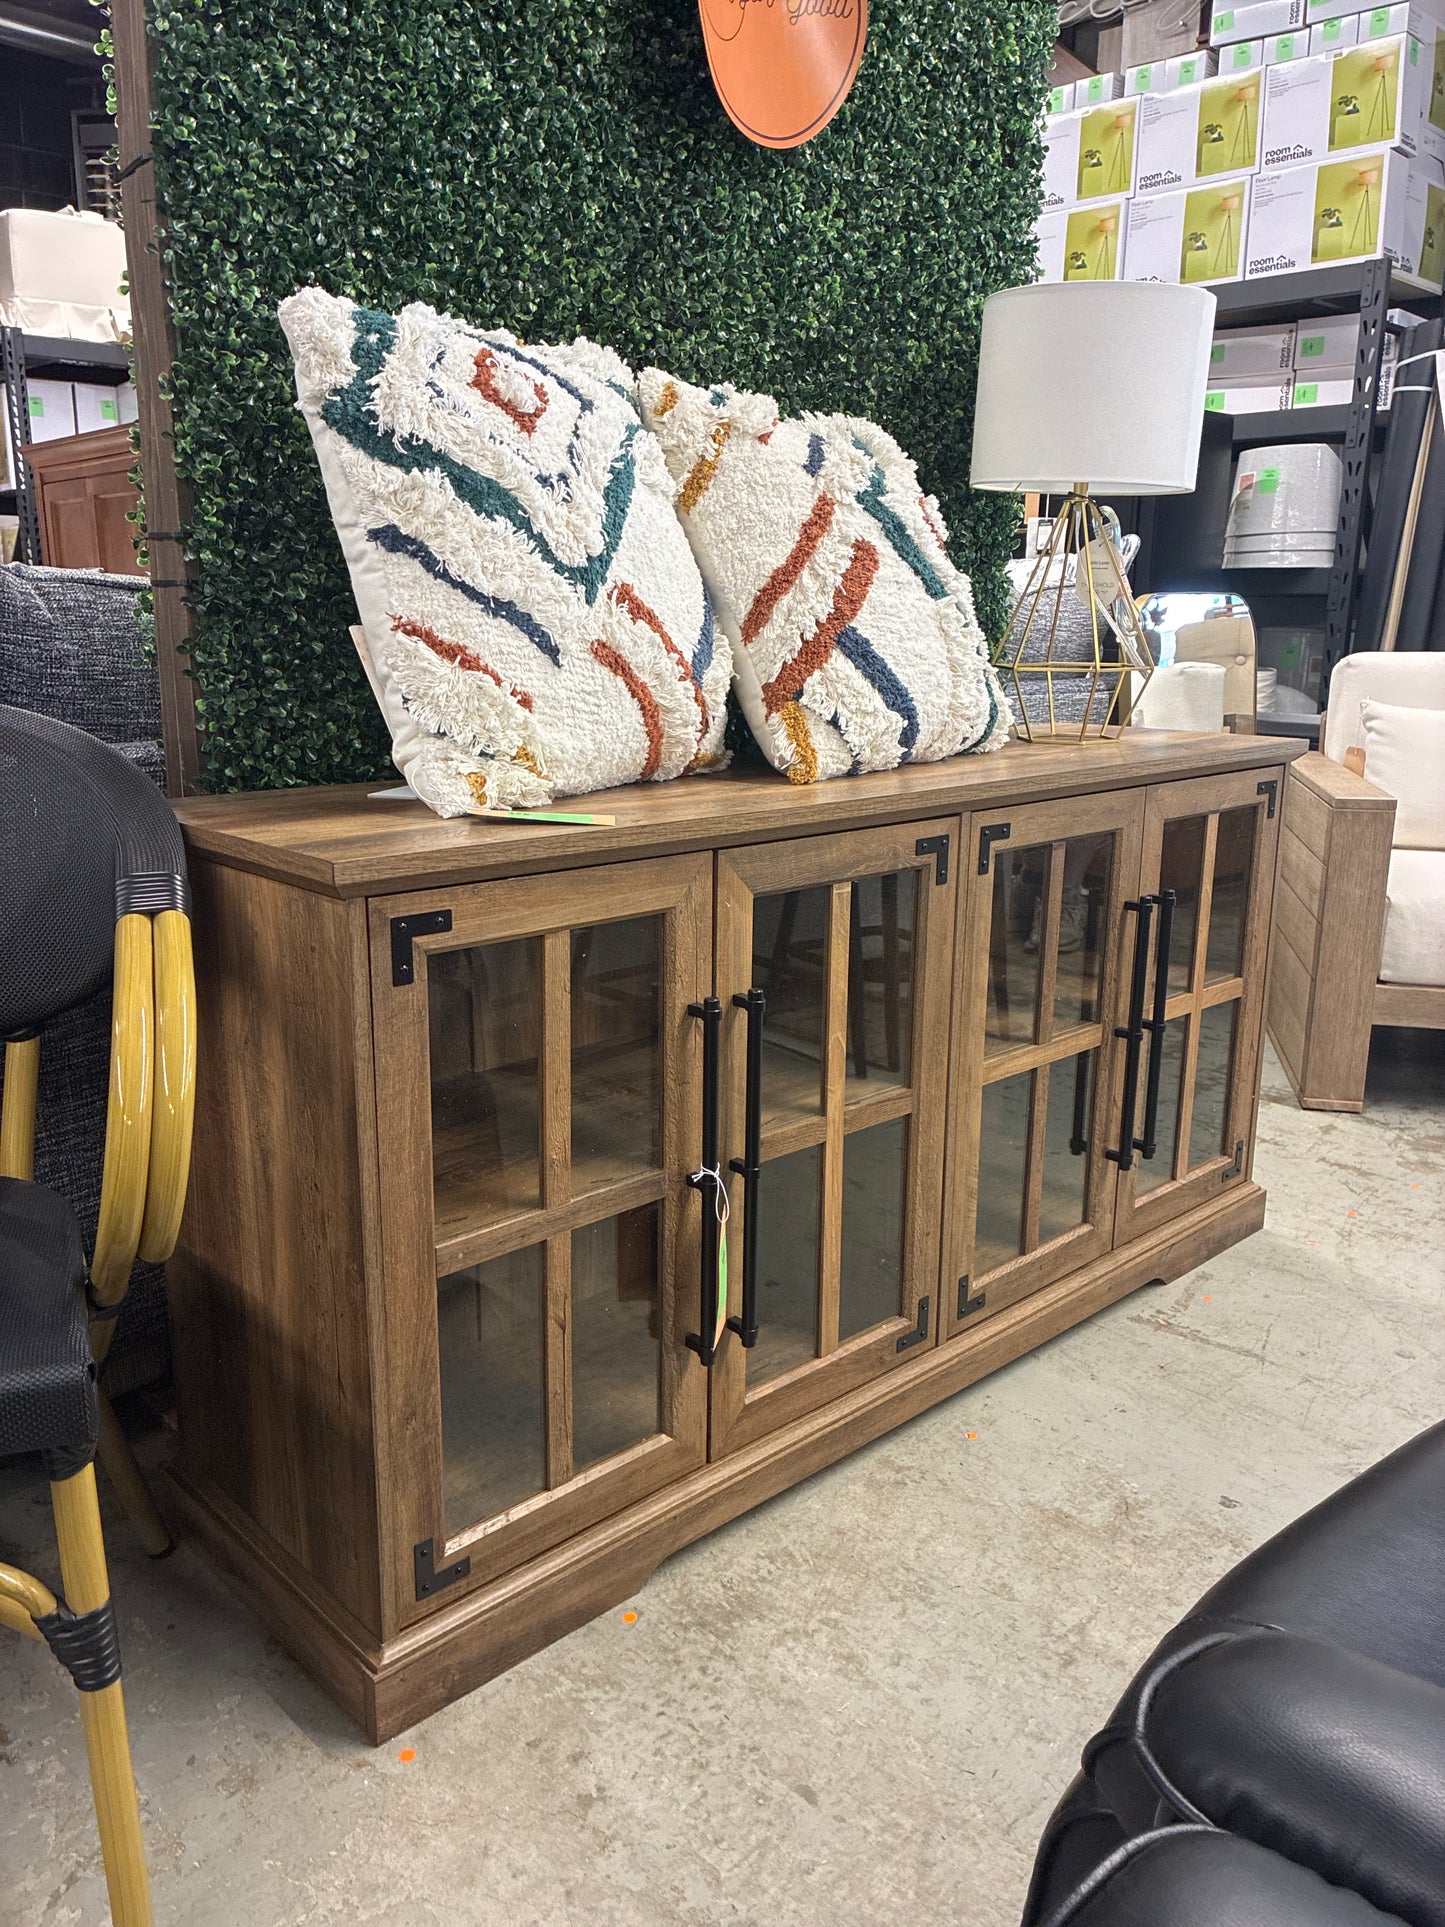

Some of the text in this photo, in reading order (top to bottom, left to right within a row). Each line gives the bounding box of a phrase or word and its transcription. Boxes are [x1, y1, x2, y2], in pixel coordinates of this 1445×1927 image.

[1265, 146, 1290, 158] room
[1265, 147, 1313, 166] essentials
[1139, 172, 1162, 183] room
[1139, 174, 1182, 190] essentials
[1042, 195, 1064, 207] ntials
[1249, 256, 1274, 267] room
[1249, 258, 1296, 275] essentials
